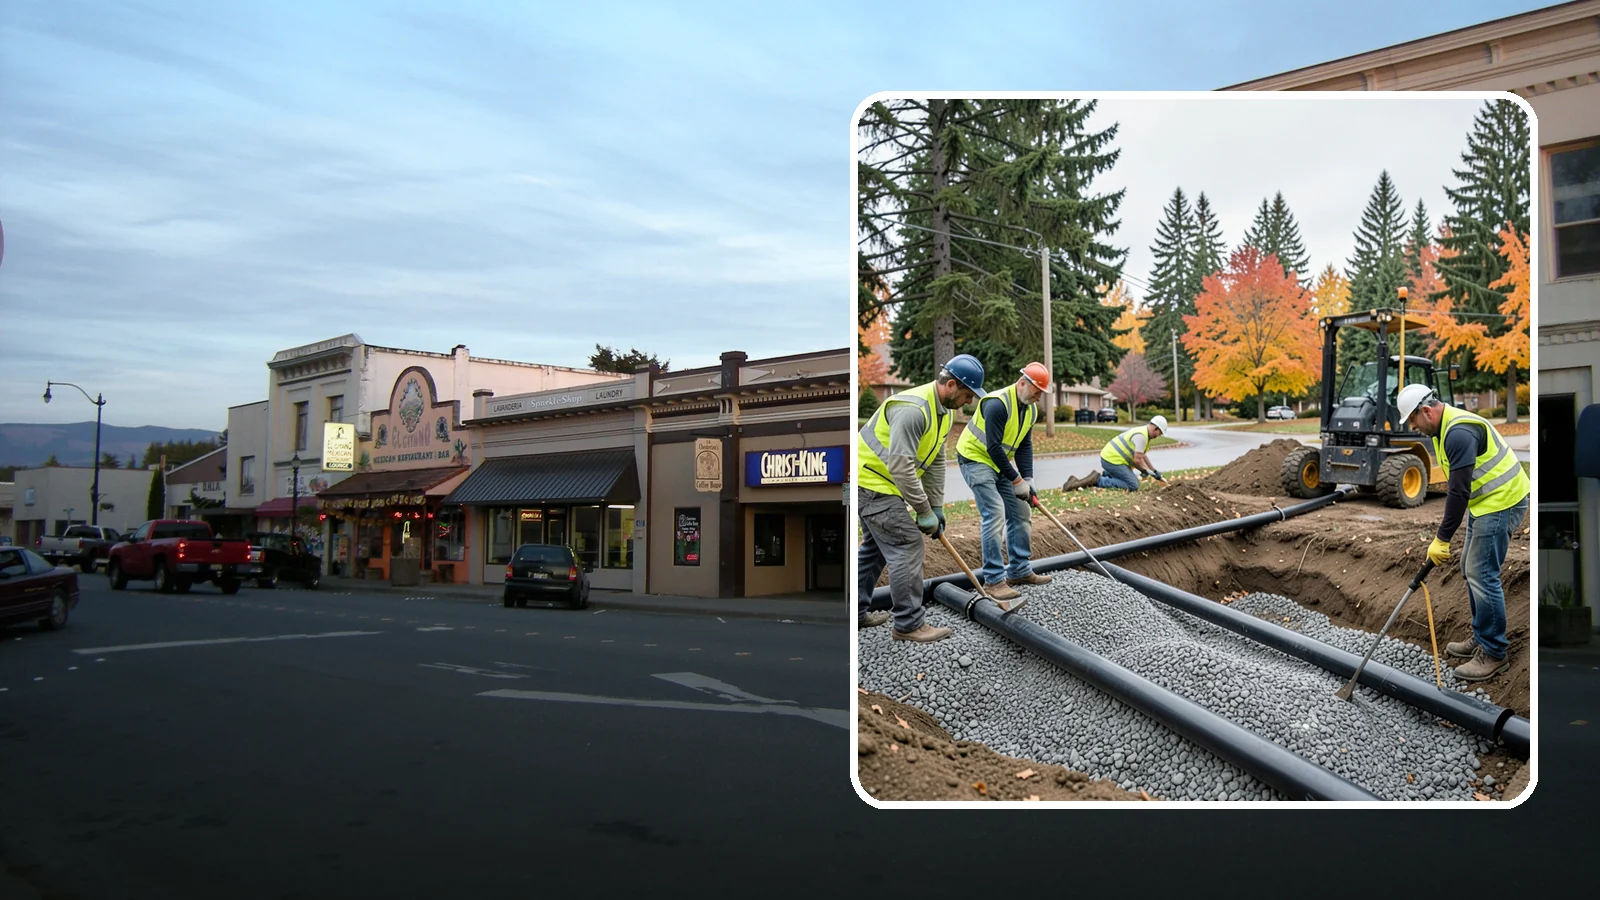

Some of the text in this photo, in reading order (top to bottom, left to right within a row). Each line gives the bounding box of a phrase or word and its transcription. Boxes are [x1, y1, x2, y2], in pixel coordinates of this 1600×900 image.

[595, 389, 623, 399] LAUNDRY
[493, 402, 522, 412] LAVANDERIA
[397, 451, 434, 462] RESTAURANT
[438, 450, 450, 459] BAR
